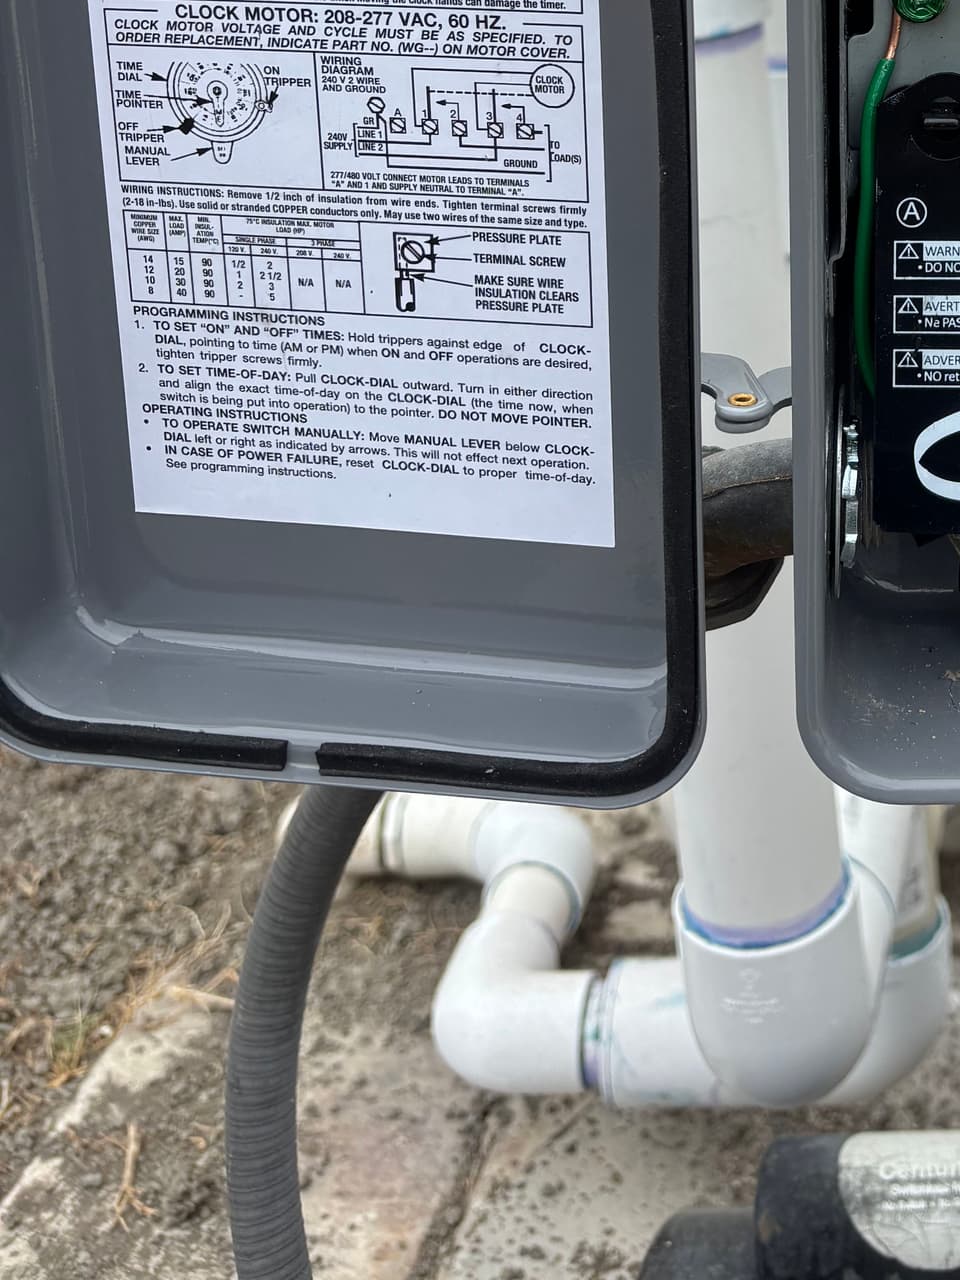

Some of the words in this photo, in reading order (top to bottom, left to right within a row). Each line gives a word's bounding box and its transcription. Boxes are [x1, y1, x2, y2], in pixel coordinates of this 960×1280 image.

[176, 4, 238, 20] CLOCK
[245, 7, 318, 23] MOTOR:
[325, 10, 393, 26] 208-277
[400, 12, 443, 30] VAC,
[449, 14, 469, 28] 60
[476, 15, 506, 29] HZ.
[116, 61, 142, 71] TIME
[264, 66, 280, 74] ON
[118, 72, 142, 82] DIAL
[265, 77, 311, 87] TRIPPER
[115, 90, 141, 99] TIME
[117, 100, 163, 109] POINTER
[118, 122, 138, 130] OFF
[119, 133, 164, 142] TRIPPER
[125, 146, 171, 156] MANUAL
[126, 157, 160, 166] LEVER
[473, 232, 526, 244] PRESSURE
[529, 235, 561, 245] PLATE
[474, 253, 526, 265] TERMINAL
[530, 256, 566, 267] SCREW
[925, 263, 942, 272] DO
[133, 306, 229, 320] PROGRAMMING
[233, 311, 325, 326] INSTRUCTIONS
[142, 404, 212, 417] OPERATING
[216, 409, 307, 423] INSTRUCTIONS
[167, 459, 187, 469] See
[191, 461, 264, 476] programming
[268, 467, 336, 479] instructions.
